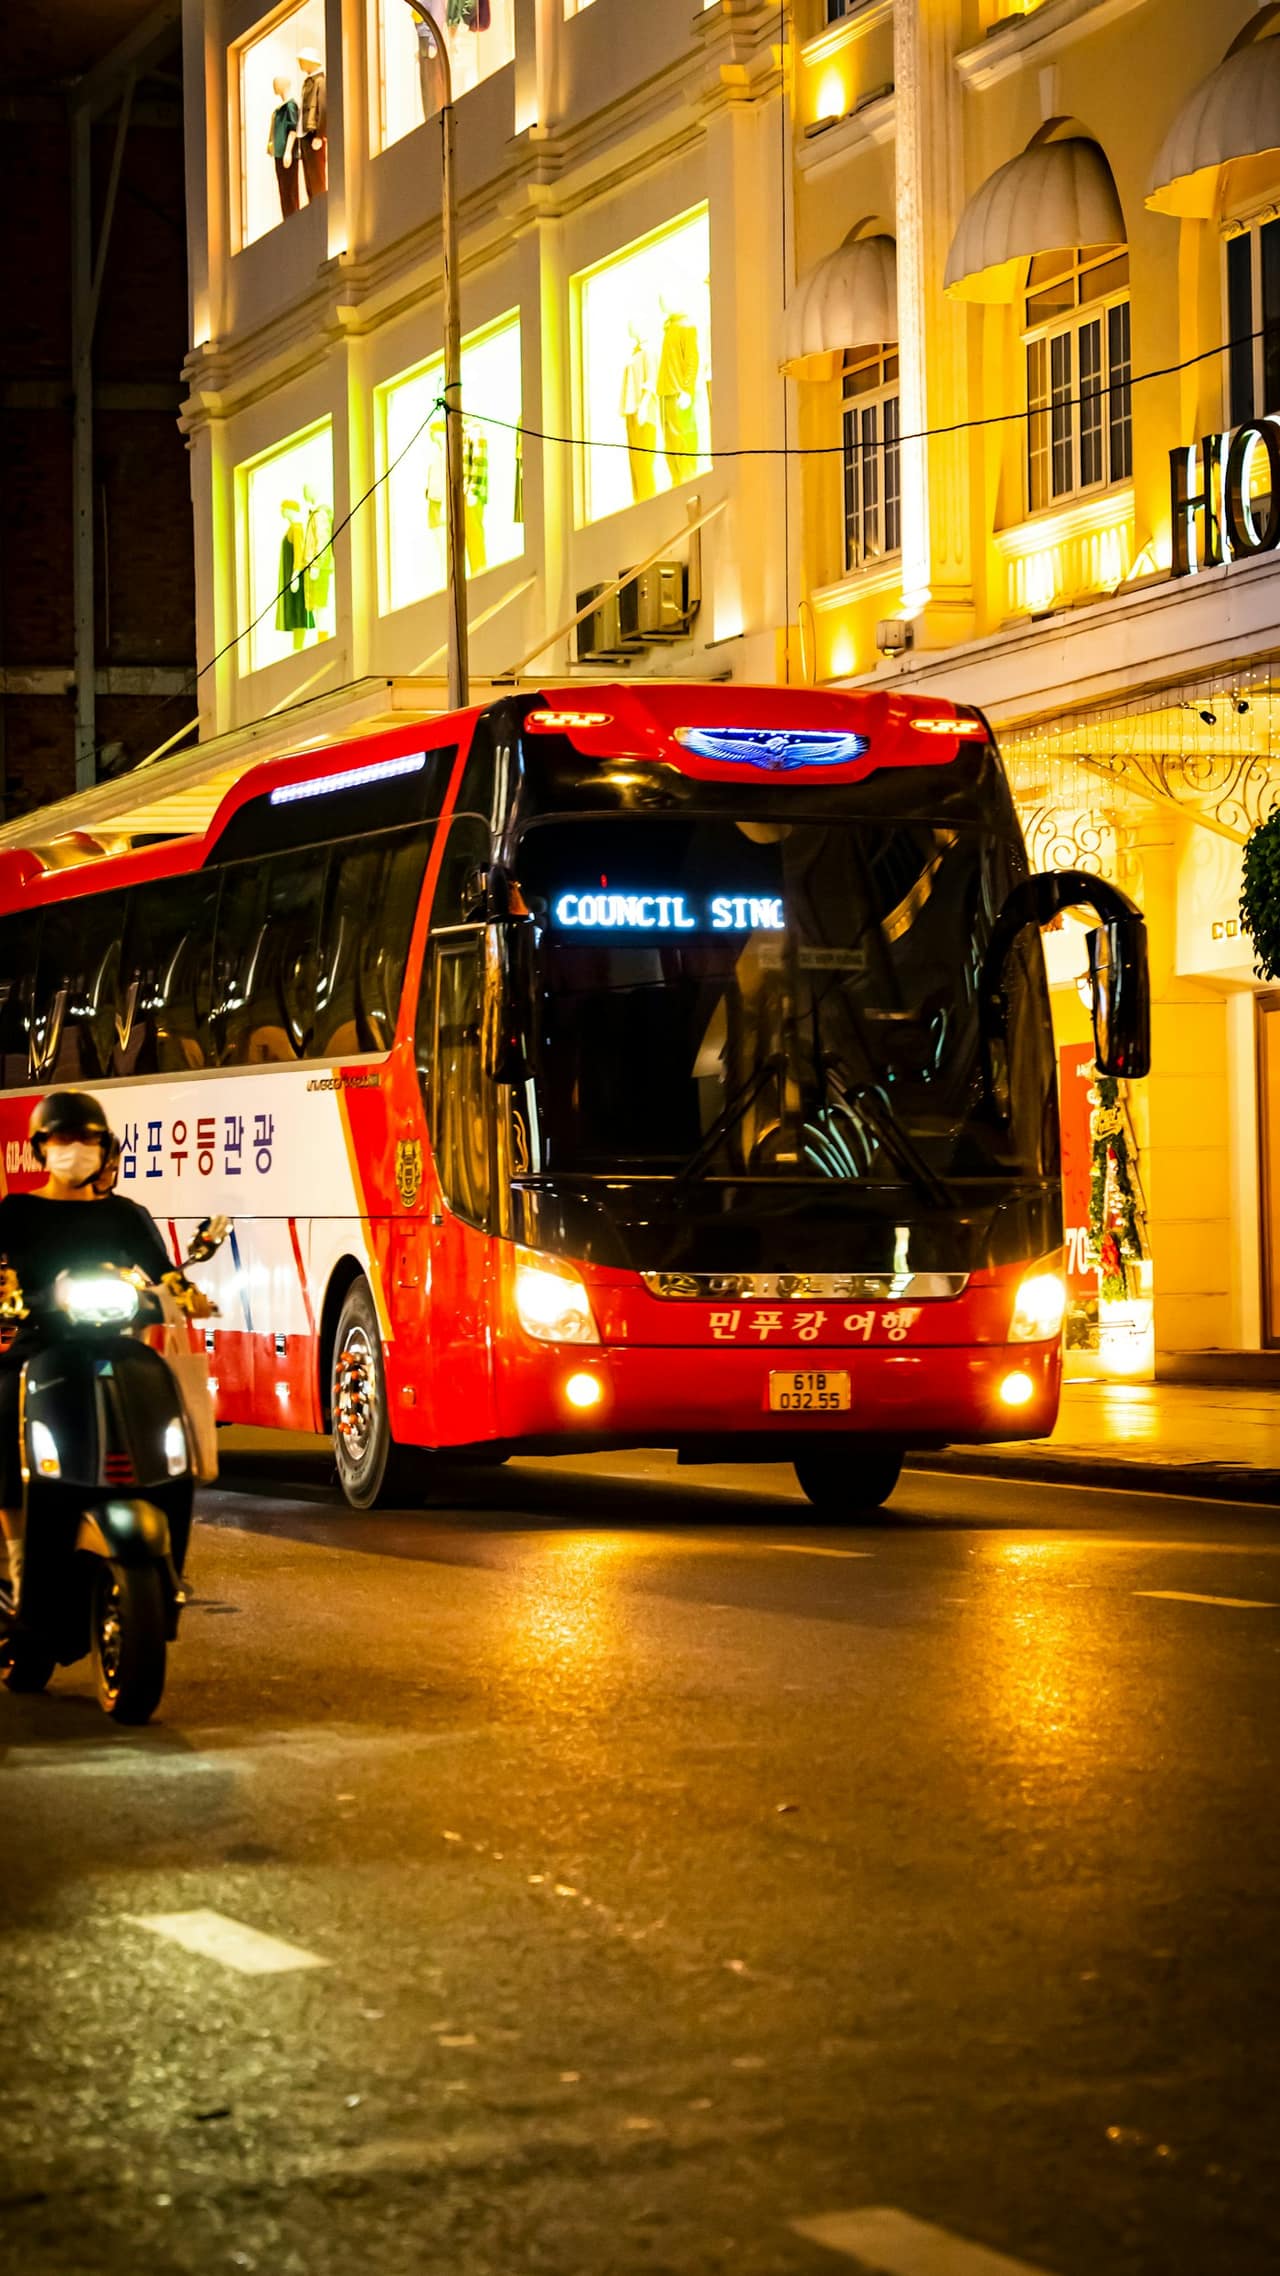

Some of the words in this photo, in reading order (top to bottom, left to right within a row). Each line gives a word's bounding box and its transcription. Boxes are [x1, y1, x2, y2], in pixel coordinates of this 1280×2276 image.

[556, 894, 695, 927] COUNCIL
[120, 1114, 275, 1178] 삼포우등관광
[709, 1310, 828, 1341] 민푸캉
[843, 1310, 915, 1341] 여행
[794, 1374, 826, 1390] 61B
[780, 1392, 840, 1409] 032.55
